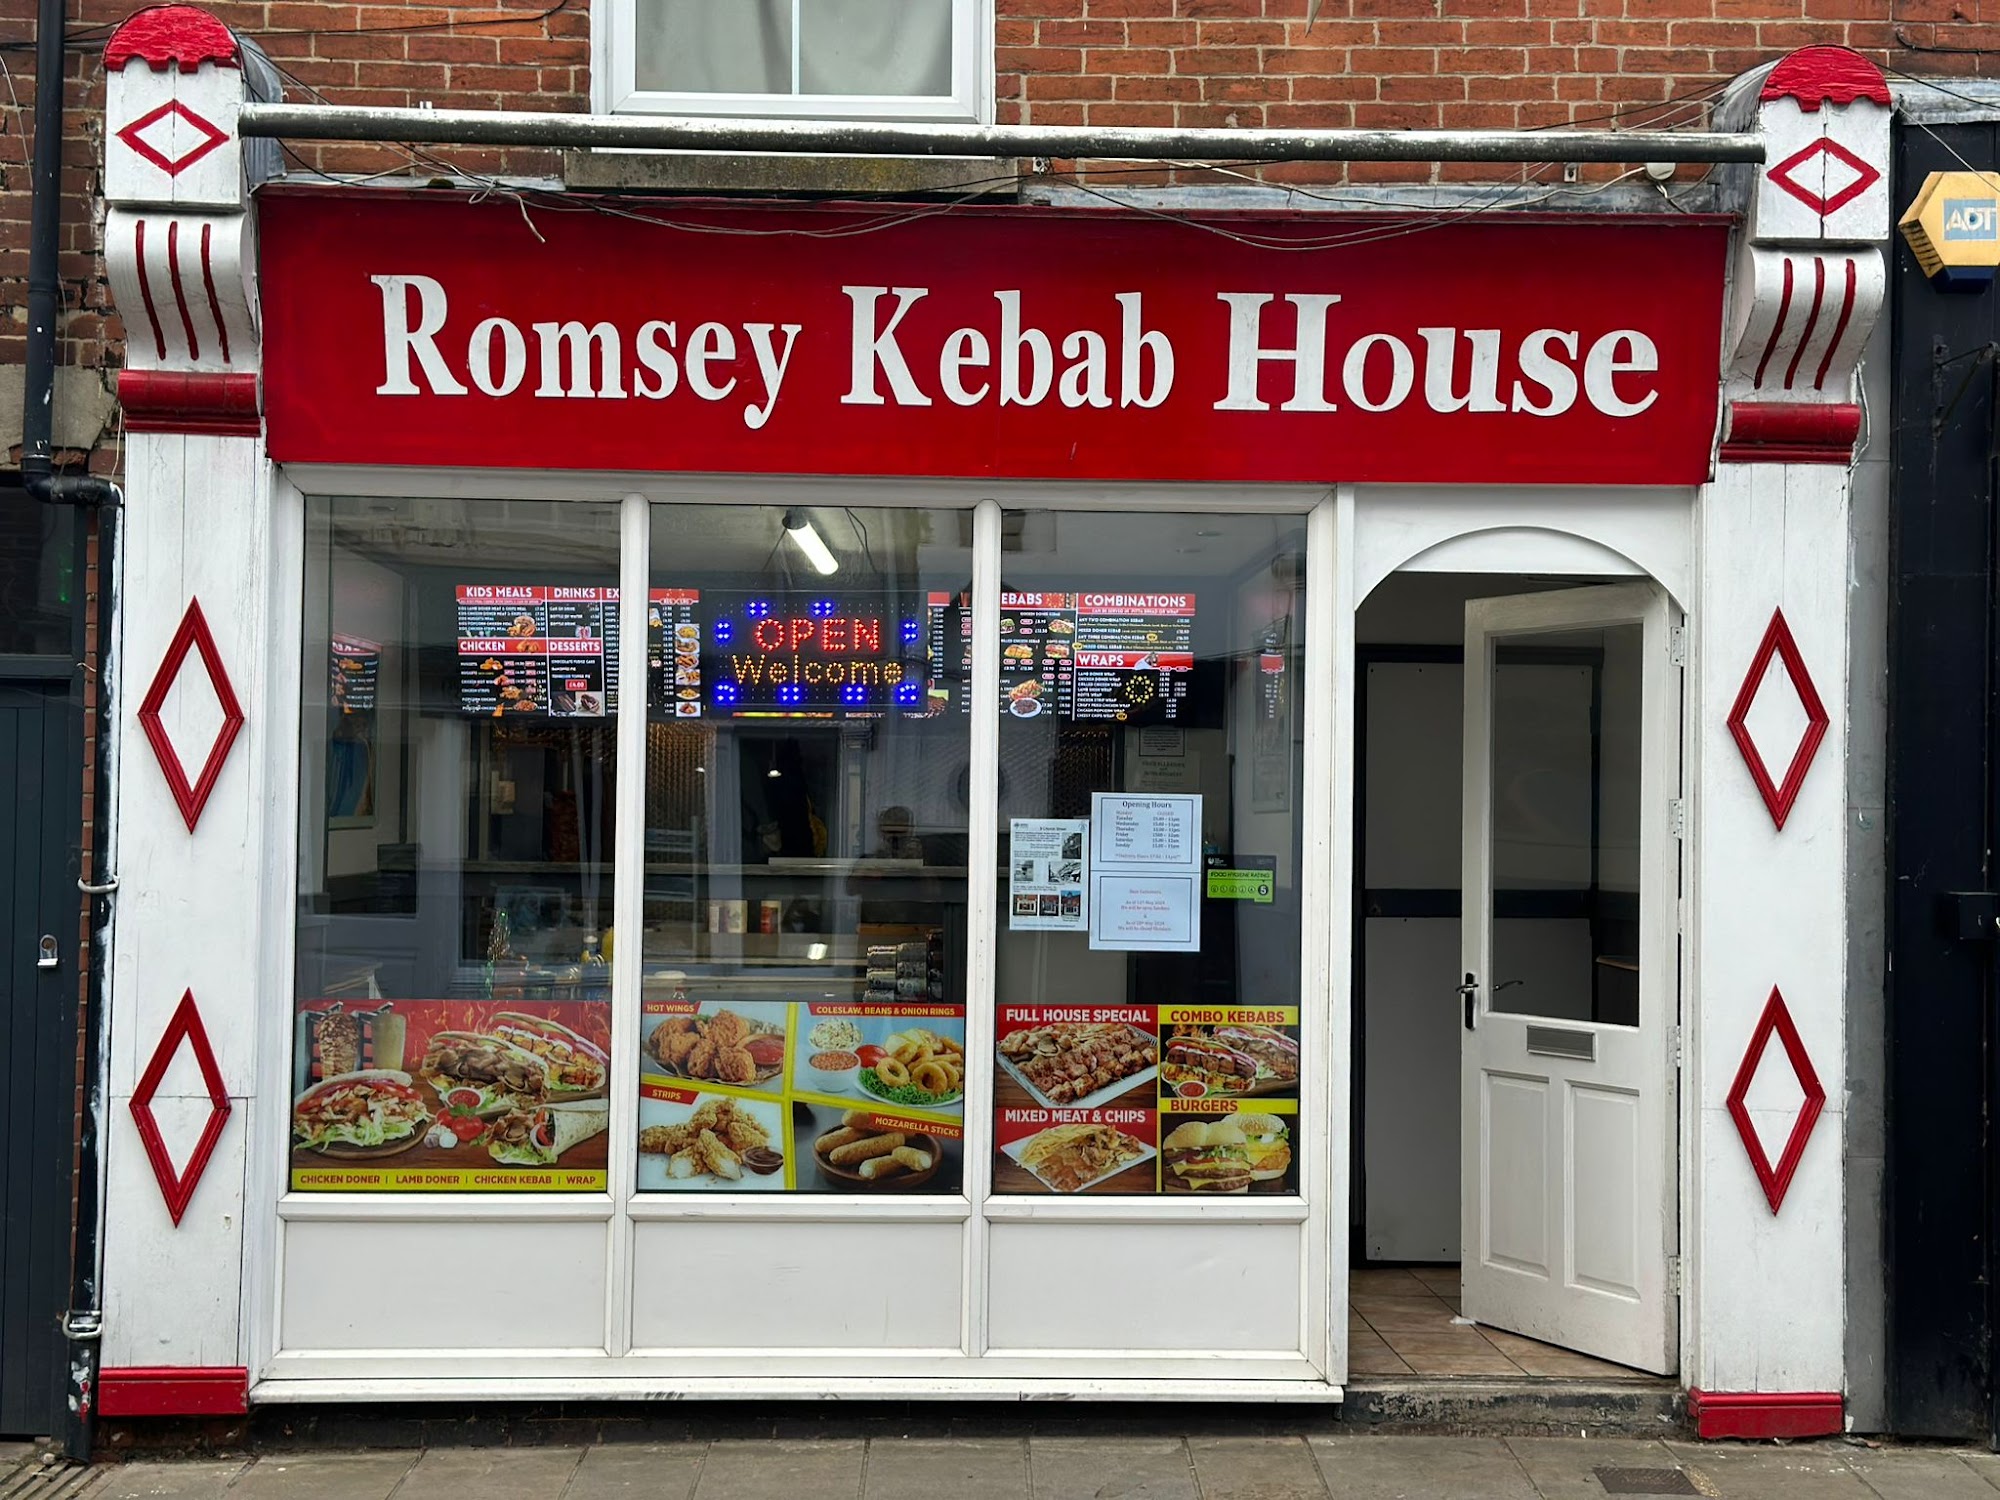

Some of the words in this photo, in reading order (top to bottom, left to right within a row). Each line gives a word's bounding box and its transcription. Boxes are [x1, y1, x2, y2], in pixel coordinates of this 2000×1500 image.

[1946, 207, 1996, 231] ADT
[371, 275, 802, 429] Romsey
[841, 285, 1174, 408] Kebab
[1213, 292, 1659, 417] House
[466, 586, 493, 598] KIDS
[496, 586, 532, 598] MEALS
[554, 587, 596, 598] DRINKS
[1001, 593, 1043, 605] EBABS
[1084, 594, 1187, 607] COMBINATIONS
[754, 617, 880, 651] OPEN
[460, 641, 506, 651] CHICKEN
[549, 642, 600, 651] DESSERTS
[1078, 654, 1124, 666] WRAPS
[731, 653, 903, 685] Welcome
[1122, 801, 1150, 809] Opening
[1260, 885, 1267, 895] 5
[647, 1003, 664, 1013] HOT
[665, 1004, 695, 1013] WINGS
[816, 1006, 862, 1016] COLESLAW,
[864, 1007, 892, 1016] BEANS
[893, 1007, 900, 1016] &
[901, 1007, 928, 1016] ONION
[929, 1007, 955, 1016] RINGS
[1006, 1009, 1041, 1022] FULL
[1044, 1009, 1090, 1022] HOUSE
[1093, 1009, 1151, 1023] SPECIAL
[1171, 1011, 1223, 1023] COMBO
[1228, 1011, 1285, 1023] KEBABS
[652, 1088, 681, 1100] STRIPS
[1171, 1100, 1238, 1112] BURGERS
[1005, 1110, 1048, 1123] MIXED
[1052, 1110, 1091, 1123] MEAT
[1092, 1110, 1102, 1123] &
[1105, 1110, 1146, 1123] CHIPS
[875, 1117, 930, 1134] MOZZARELLA
[930, 1125, 960, 1138] STICKS
[300, 1175, 343, 1184] CHICKEN
[346, 1175, 380, 1184] DONER
[396, 1175, 424, 1184] LAMB
[425, 1175, 460, 1184] DONER
[474, 1175, 517, 1184] CHICKEN
[519, 1175, 552, 1184] KEBAB
[566, 1175, 596, 1184] WRAP
